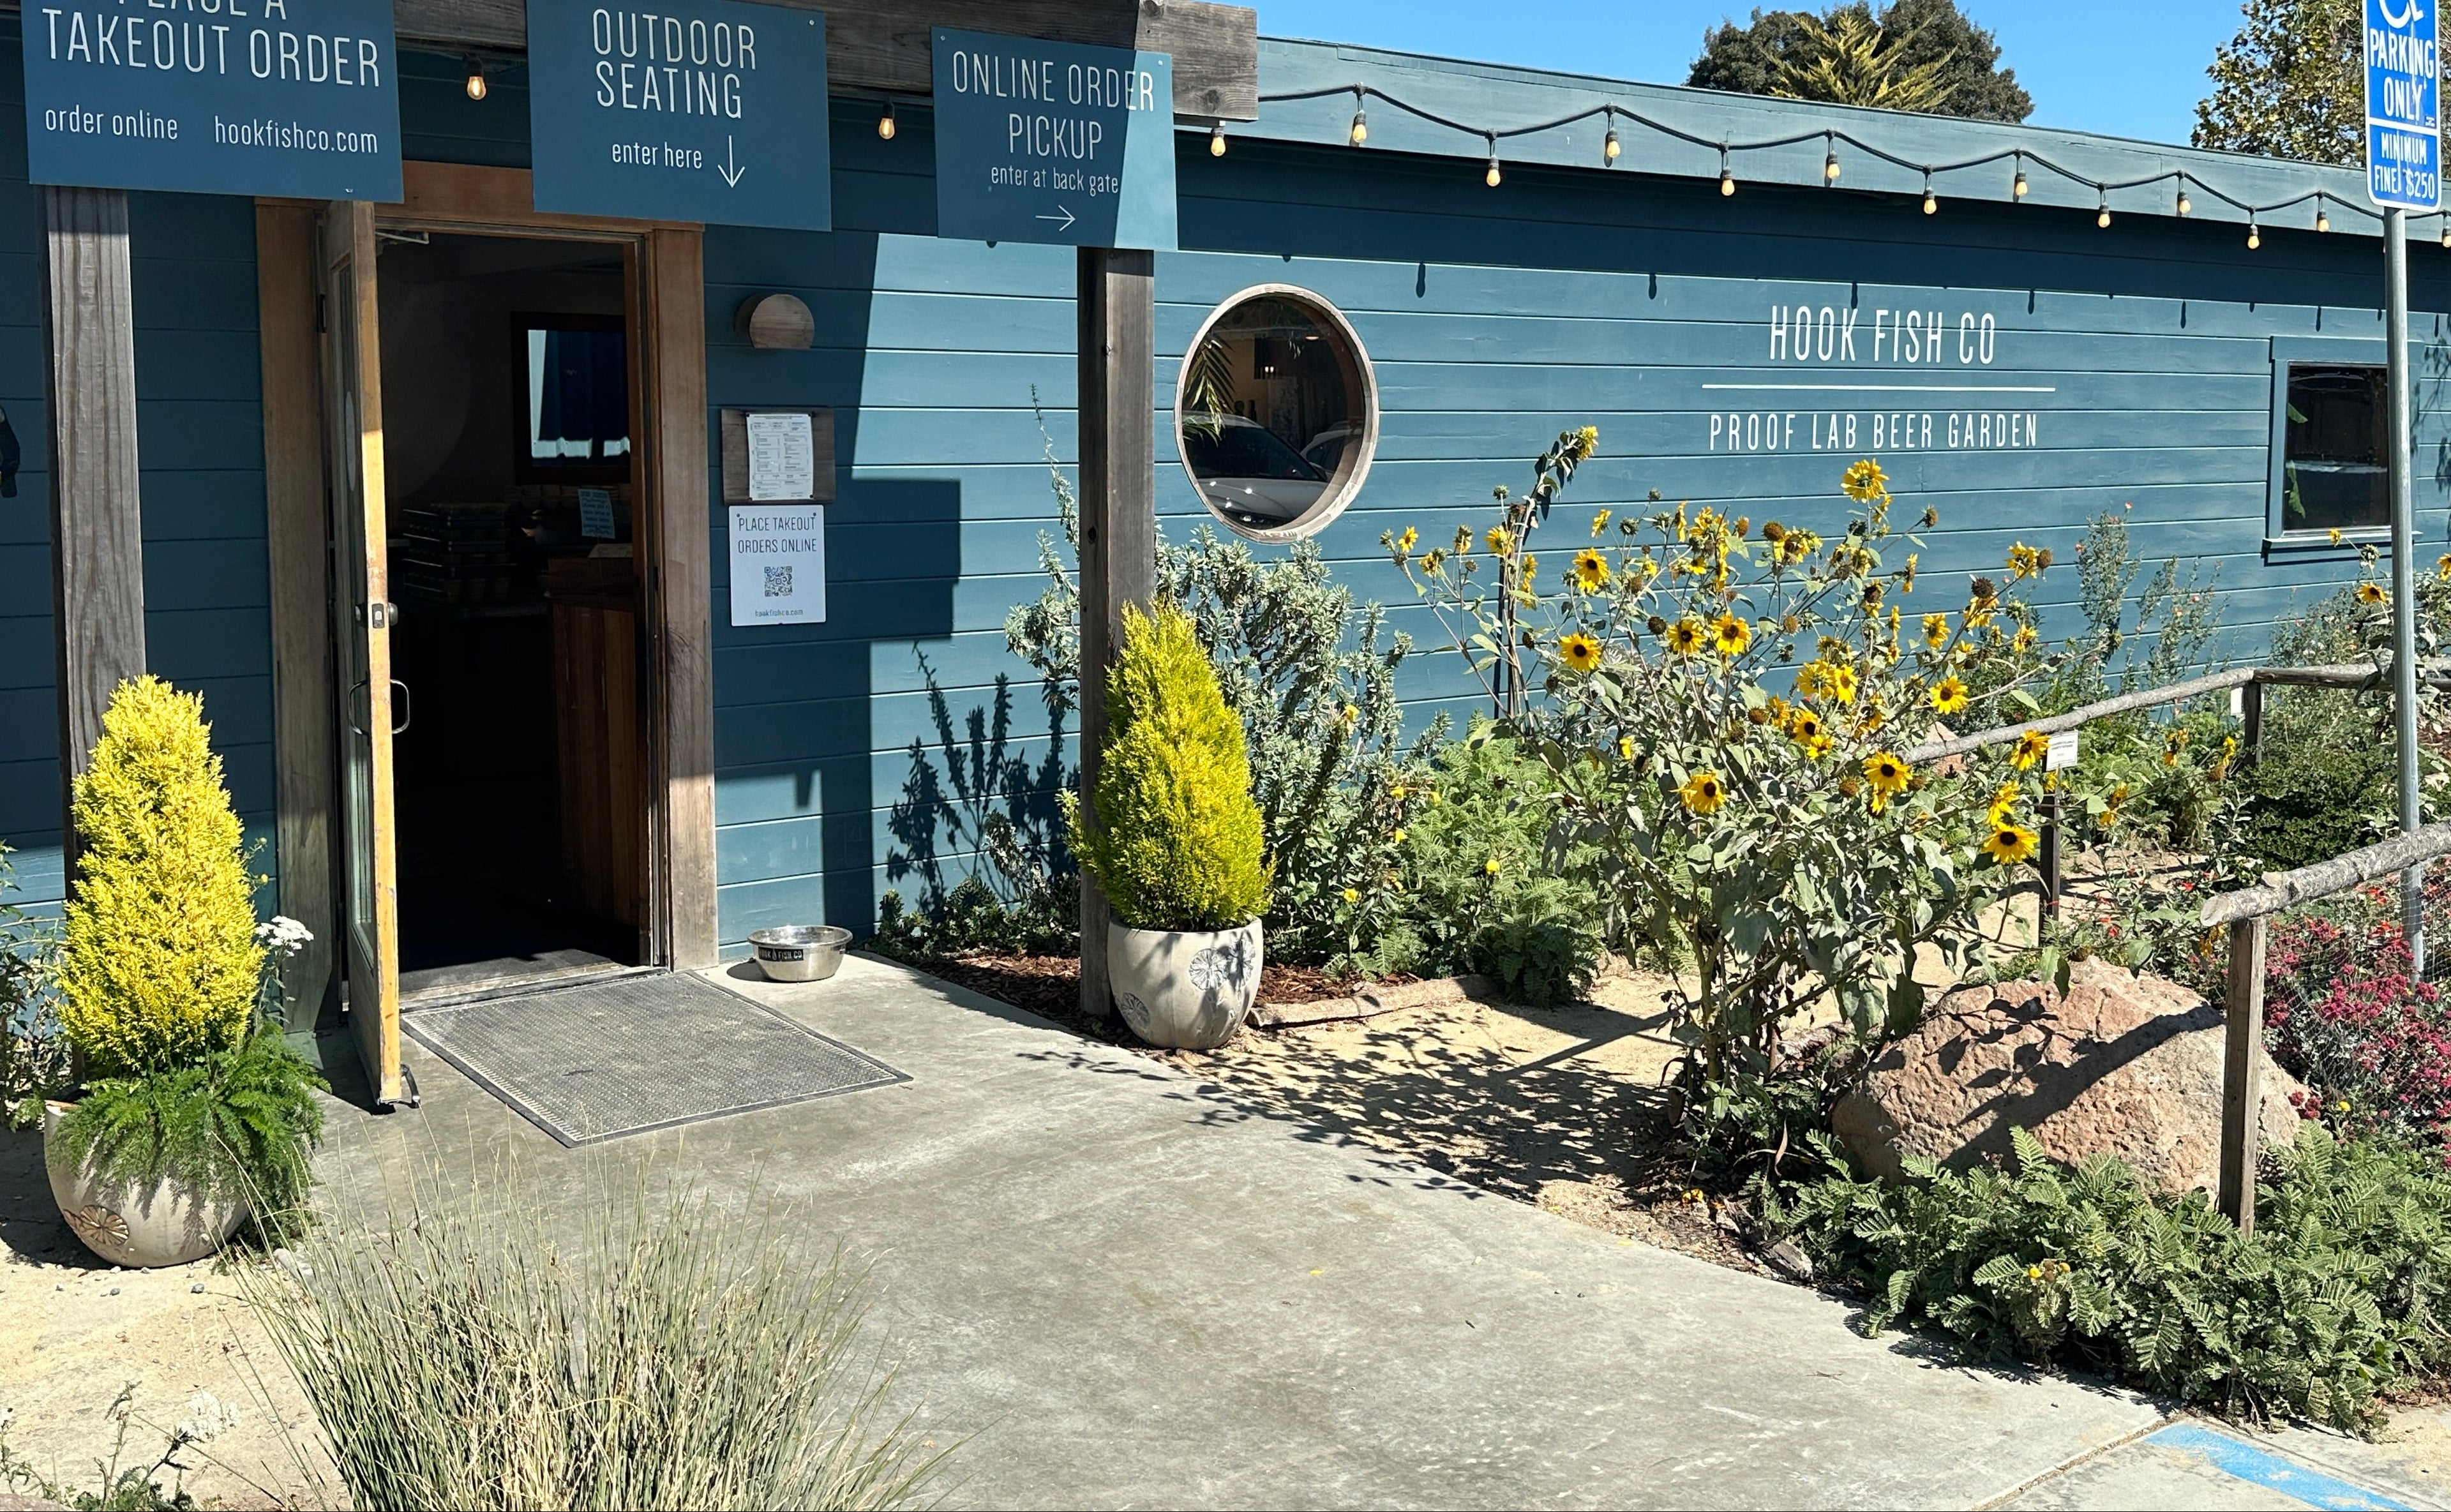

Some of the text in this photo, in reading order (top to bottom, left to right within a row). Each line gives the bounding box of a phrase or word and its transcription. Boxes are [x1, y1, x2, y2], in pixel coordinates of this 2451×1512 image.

[42, 8, 380, 87] TAKEOUT ORDER
[592, 8, 757, 70] OUTDOOR
[2369, 28, 2434, 79] PARKING
[596, 61, 742, 119] SEATING
[953, 50, 1154, 112] ONLINE ORDER
[2383, 77, 2423, 121] ONLY
[45, 104, 179, 140] order online
[214, 116, 379, 154] hookfishco.com
[1008, 113, 1102, 160] PICKUP
[612, 141, 702, 169] enter here
[2381, 131, 2427, 165] MINIMUM
[991, 165, 1119, 197] enter at back gate
[2374, 164, 2435, 200] FINE $250
[1769, 305, 1995, 364] HOOK FISH CO
[1710, 413, 2037, 451] PROOF LAB BEER GARDEN
[738, 516, 816, 532] PLACE TAKEOUT
[738, 539, 817, 554] ORDERS ONLINE
[793, 950, 802, 959] CO
